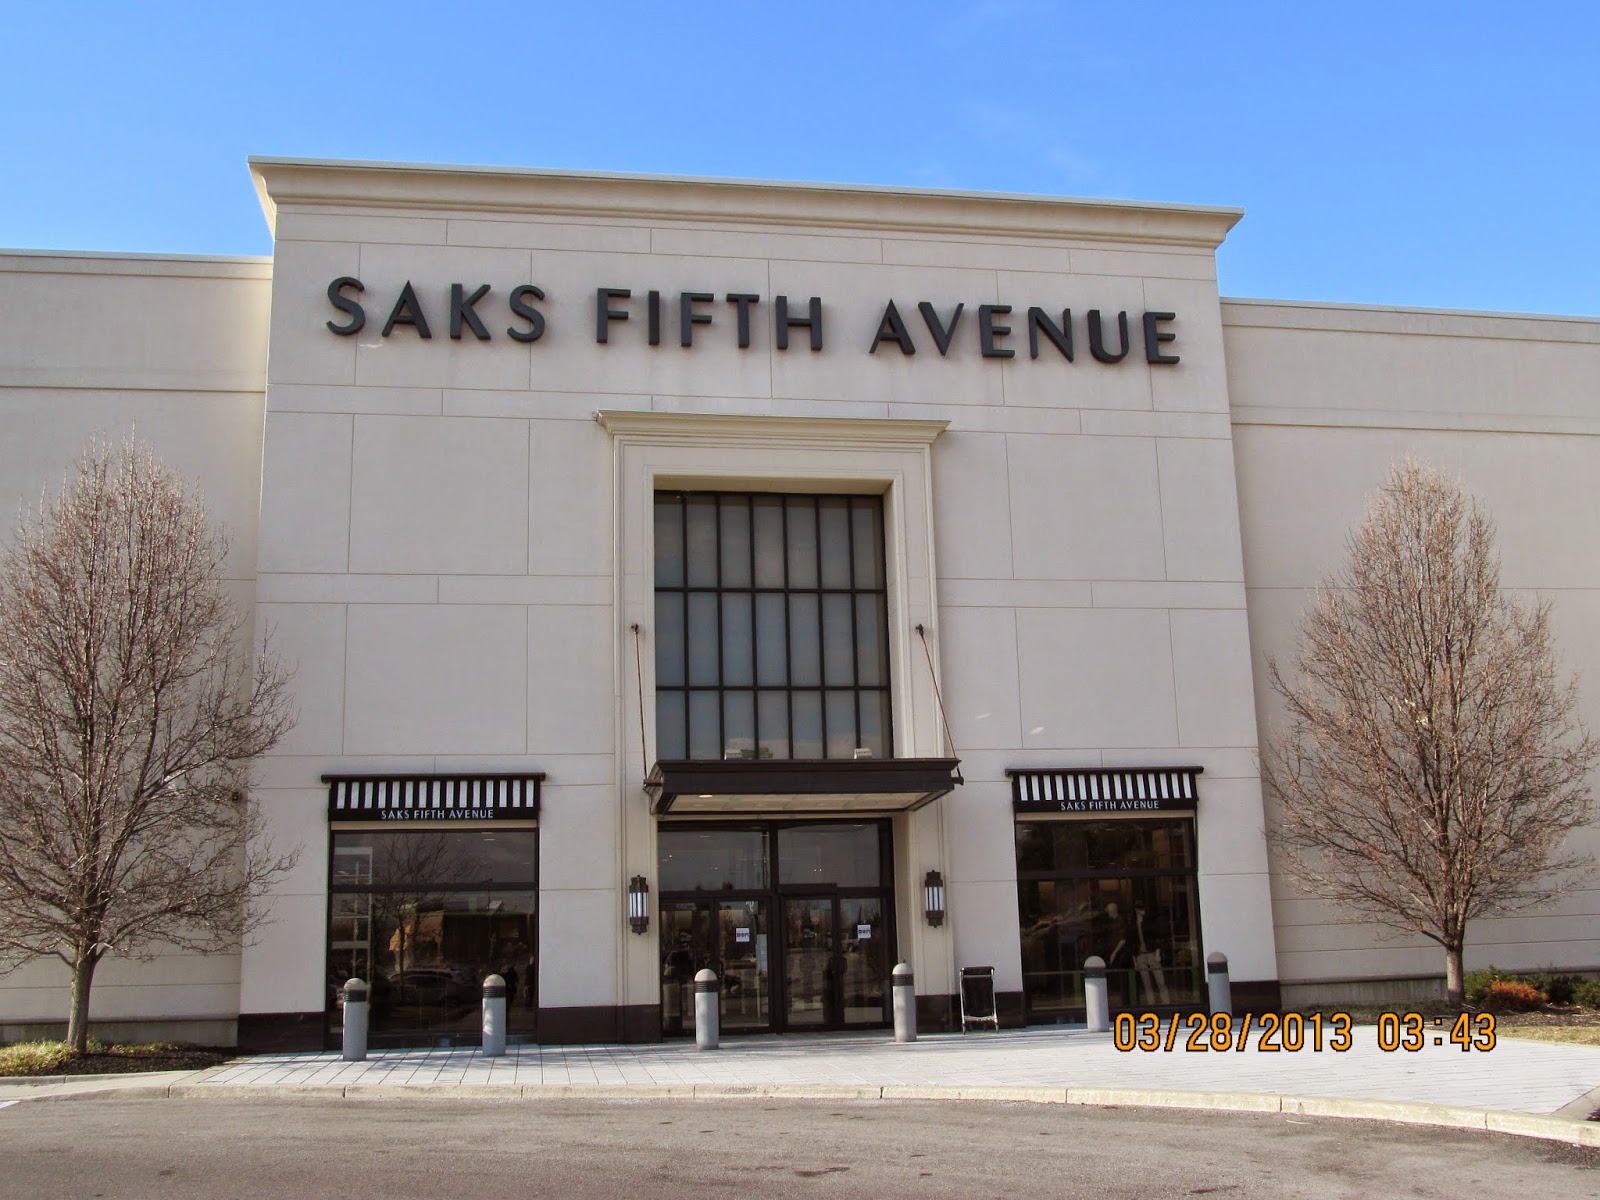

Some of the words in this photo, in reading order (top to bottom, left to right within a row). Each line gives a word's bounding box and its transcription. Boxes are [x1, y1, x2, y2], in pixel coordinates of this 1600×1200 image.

[326, 276, 546, 342] SAKS
[596, 287, 823, 352] FIFTH
[869, 298, 1181, 364] AVENUE
[1060, 801, 1086, 811] SAKS
[1089, 801, 1117, 811] FIFTH
[1119, 800, 1160, 810] AVENUE
[381, 809, 410, 820] SAKS
[413, 809, 445, 820] FIFTH
[448, 809, 494, 819] AVENUE
